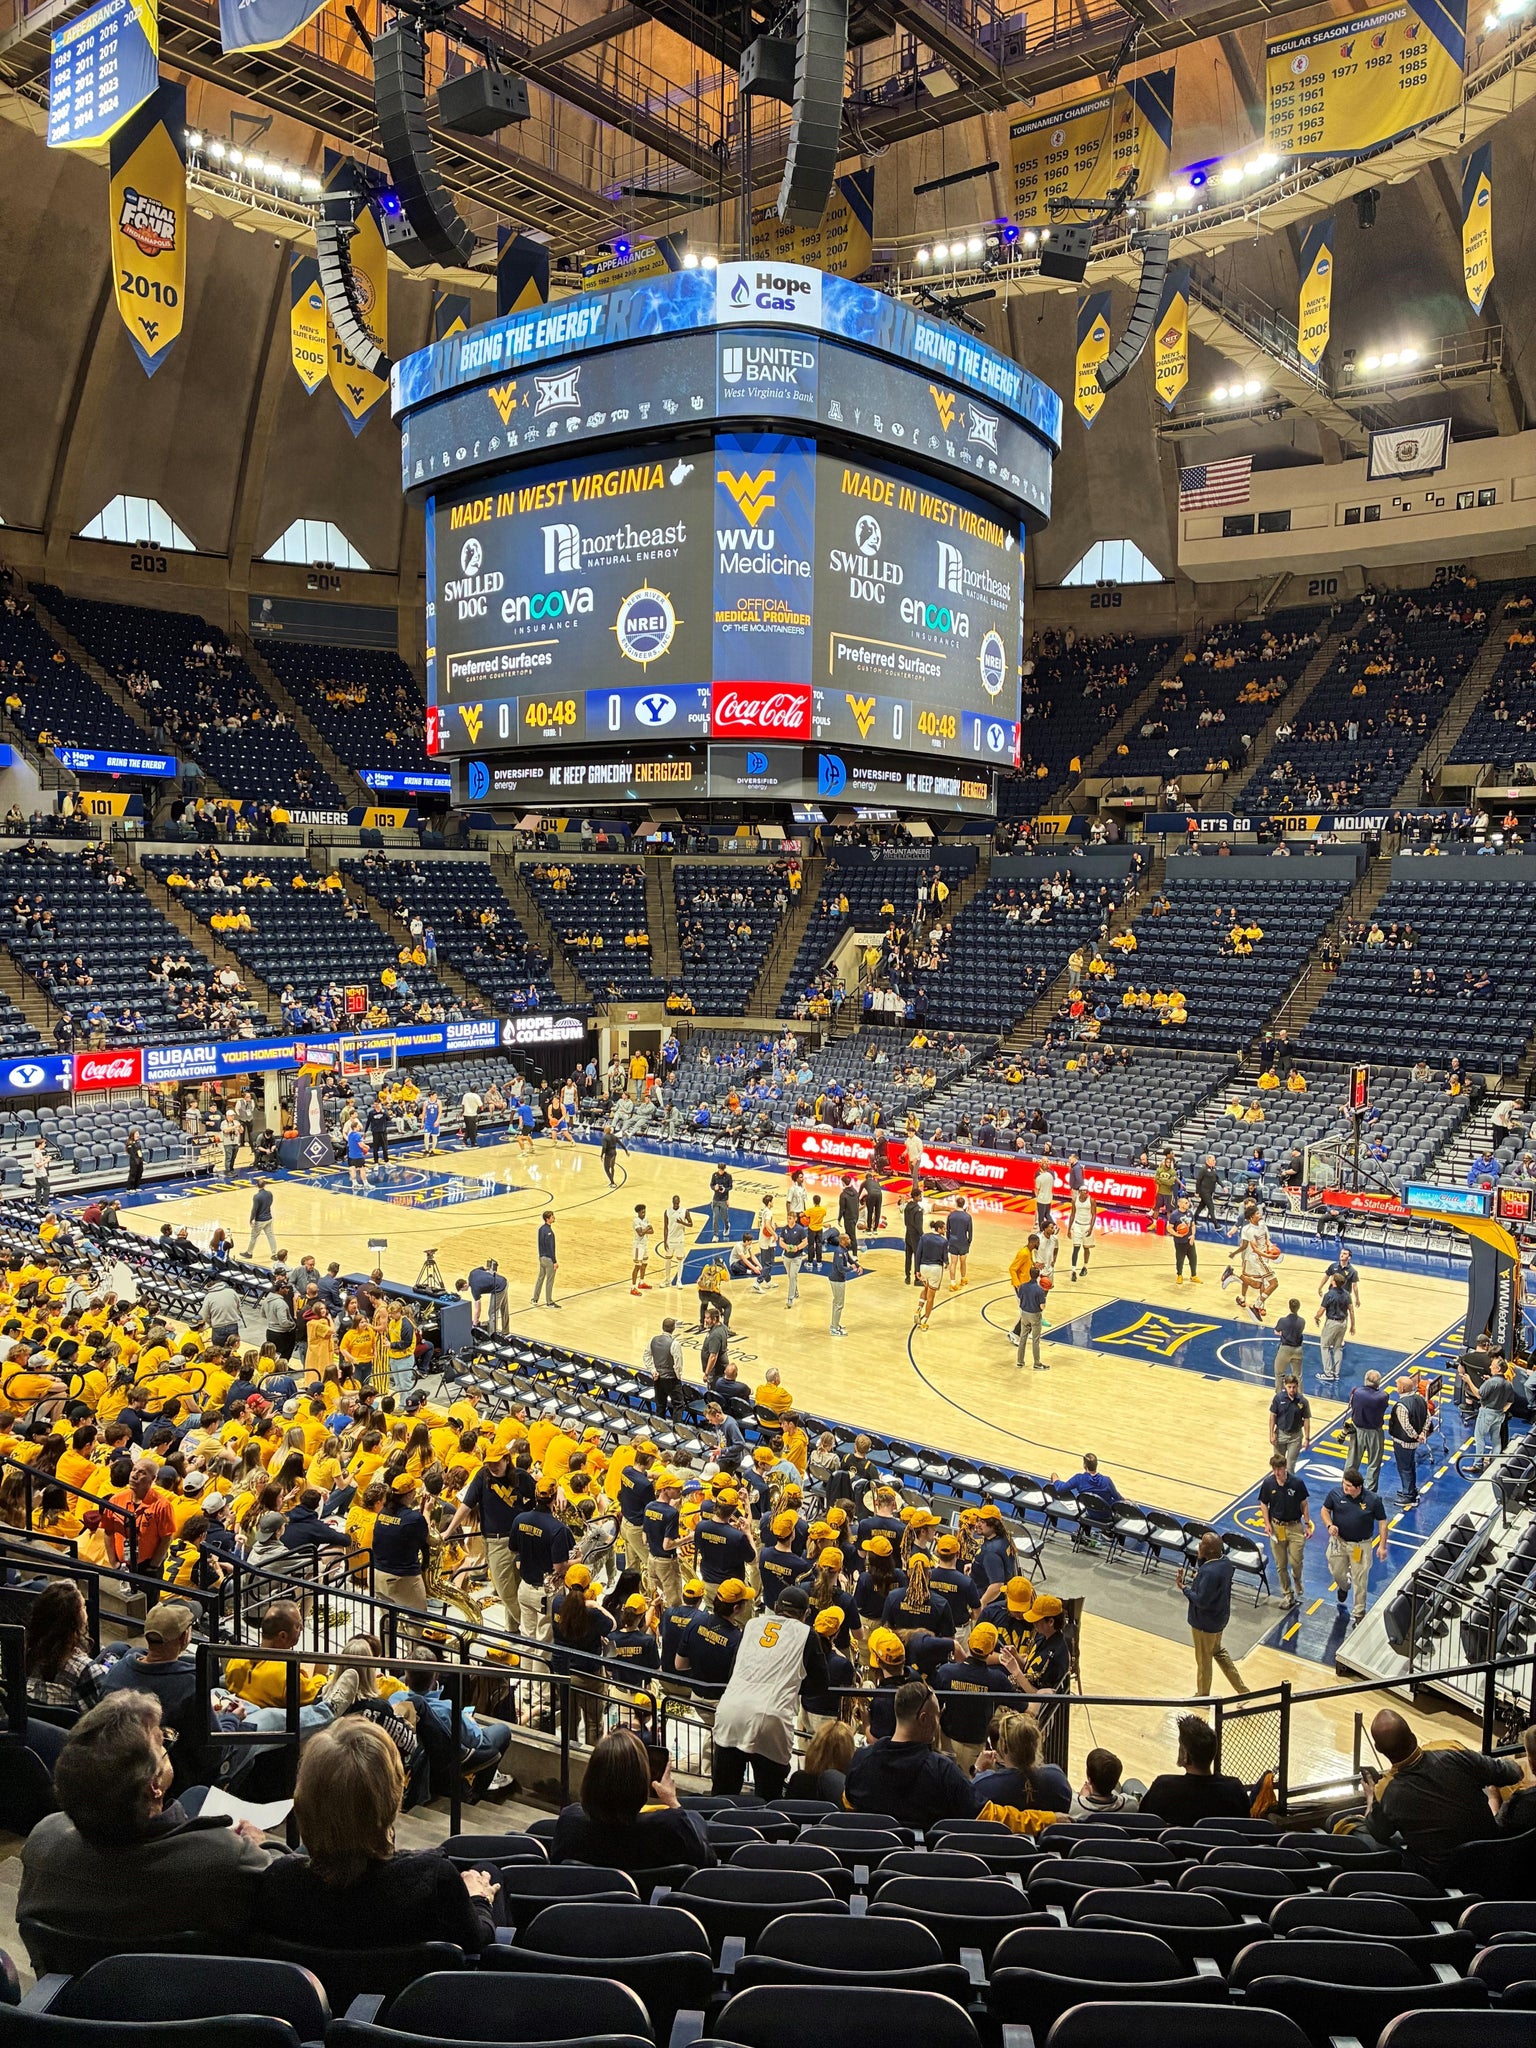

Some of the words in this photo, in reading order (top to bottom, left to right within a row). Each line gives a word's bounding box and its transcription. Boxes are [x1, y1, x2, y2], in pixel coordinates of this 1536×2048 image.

[1270, 37, 1311, 55] REGULAR
[1312, 25, 1349, 44] SEASON
[1350, 8, 1407, 32] CHAMPIONS
[75, 72, 94, 93] 2012
[99, 58, 118, 79] 2021
[1271, 80, 1295, 96] 1952
[1299, 73, 1326, 89] 1959
[1331, 64, 1358, 79] 1977
[1365, 54, 1393, 70] 1982
[1399, 43, 1428, 60] 1983
[1270, 96, 1295, 111] 1955
[1298, 87, 1324, 102] 1961
[1399, 58, 1427, 75] 1985
[1270, 110, 1295, 126] 1956
[1298, 102, 1325, 118] 1962
[1398, 74, 1427, 90] 1989
[1012, 113, 1063, 135] TOURNAMENT
[1064, 98, 1110, 119] CHAMPIONS
[1297, 117, 1325, 132] 1963
[1297, 131, 1324, 146] 1967
[1014, 158, 1039, 174] 1955
[1044, 149, 1069, 165] 1959
[1074, 140, 1100, 156] 1965
[1113, 127, 1139, 143] 1983
[1014, 175, 1038, 190] 1956
[1044, 165, 1069, 181] 1960
[1074, 156, 1098, 172] 1967
[1113, 144, 1140, 160] 1984
[1014, 191, 1037, 206] 1957
[1043, 182, 1068, 197] 1962
[137, 196, 175, 223] FINAL
[1013, 206, 1037, 222] 1958
[121, 203, 175, 241] FOUR
[126, 227, 171, 247] INDIANAPOLIS
[801, 233, 821, 247] 1993
[826, 224, 848, 239] 2004
[775, 242, 795, 255] 1981
[801, 251, 821, 264] 1994
[826, 242, 848, 256] 2007
[596, 246, 656, 273] APPEARANCES
[121, 270, 178, 307] 2010
[756, 273, 811, 295] Hope
[756, 292, 796, 311] Gas
[460, 332, 503, 372] BRING
[506, 323, 534, 357] THE
[535, 305, 602, 349] ENERGY
[295, 347, 324, 365] 2005
[746, 348, 814, 368] UNITED
[914, 324, 956, 366] BRING
[958, 344, 981, 379] THE
[981, 355, 1020, 400] ENERGY
[1156, 355, 1186, 368] CHAMPION
[746, 366, 798, 383] BANK
[1157, 363, 1185, 380] 2007
[724, 388, 745, 398] West
[748, 387, 791, 399] Virginia's
[793, 390, 814, 403] Bank
[610, 409, 629, 423] TCU
[451, 497, 493, 530] MADE
[497, 493, 515, 517] IN
[518, 480, 568, 513] WEST
[571, 464, 665, 503] VIRGINIA
[841, 469, 896, 507] MADE
[898, 486, 917, 513] IN
[919, 493, 957, 527] WEST
[958, 507, 1004, 549] VIRGINIA
[581, 519, 687, 555] northeast
[716, 529, 775, 551] WVU
[130, 553, 168, 573] 203
[587, 554, 632, 568] NATURAL
[636, 548, 679, 562] ENERGY
[720, 552, 811, 578] Medicine
[829, 549, 904, 586] SWILLED
[307, 574, 342, 592] 204
[444, 571, 504, 602] SWILLED
[850, 577, 886, 605] DOG
[963, 564, 1012, 601] northeast
[1308, 578, 1338, 596] 210
[501, 586, 594, 624] encova
[737, 598, 793, 613] OFFICIAL
[966, 589, 989, 604] NATURAL
[1090, 592, 1122, 609] 209
[458, 596, 488, 620] DOG
[900, 596, 969, 638] encova
[513, 620, 579, 635] INSURANCE
[627, 616, 664, 632] NREI
[715, 611, 761, 623] MEDICAL
[764, 612, 811, 626] PROVIDER
[750, 624, 805, 635] MOUNTAINEERS
[911, 630, 960, 649] INSURANCE
[451, 654, 498, 678] Preferred
[501, 652, 552, 670] Surfaces
[837, 643, 895, 668] Preferred
[898, 654, 941, 677] Surfaces
[985, 654, 1002, 669] NREI
[489, 668, 533, 680] COUNTERTOPS
[697, 688, 711, 696] TOL
[813, 690, 824, 700] TOL
[498, 704, 509, 738] 0
[525, 700, 577, 727] 40:48
[608, 694, 621, 732] 0
[688, 713, 711, 723] FOULS
[715, 692, 808, 728] Coca-Cola
[812, 716, 831, 726] FOULS
[893, 705, 903, 740] 0
[917, 711, 956, 739] 40:48
[974, 718, 981, 751] 0
[72, 751, 95, 762] Hope
[106, 756, 128, 768] BRING
[129, 757, 141, 769] THE
[141, 759, 167, 770] ENERGY
[404, 776, 422, 786] BRING
[494, 768, 544, 779] DIVERSIFIED
[563, 767, 584, 785] KEEP
[588, 763, 633, 785] GAMEDAY
[635, 761, 692, 783] ENERGIZED
[737, 777, 778, 785] DIVERSIFIED
[852, 767, 902, 782] DIVERSIFIED
[494, 781, 517, 791] energy
[852, 780, 878, 792] energy
[917, 775, 933, 794] KEEP
[934, 777, 960, 797] GAMEDAY
[961, 781, 988, 800] ENERGIZED
[91, 799, 112, 815] 101
[374, 813, 395, 827] 103
[1040, 822, 1059, 835] 107
[1233, 819, 1251, 831] GO
[1282, 818, 1307, 831] 108
[883, 848, 931, 856] MOUNTAINEER
[447, 1022, 495, 1037] SUBARU
[516, 1017, 553, 1031] HOPE
[447, 1038, 495, 1049] MORGANTOWN
[516, 1027, 584, 1043] COLISEUM
[149, 1047, 216, 1066] SUBARU
[222, 1052, 250, 1063] YOUR
[413, 1034, 443, 1045] VALUES
[81, 1058, 135, 1082] Coca-Cola
[148, 1065, 216, 1080] MORGANTOWN
[1504, 1203, 1524, 1216] 30
[759, 1621, 782, 1648] 5
